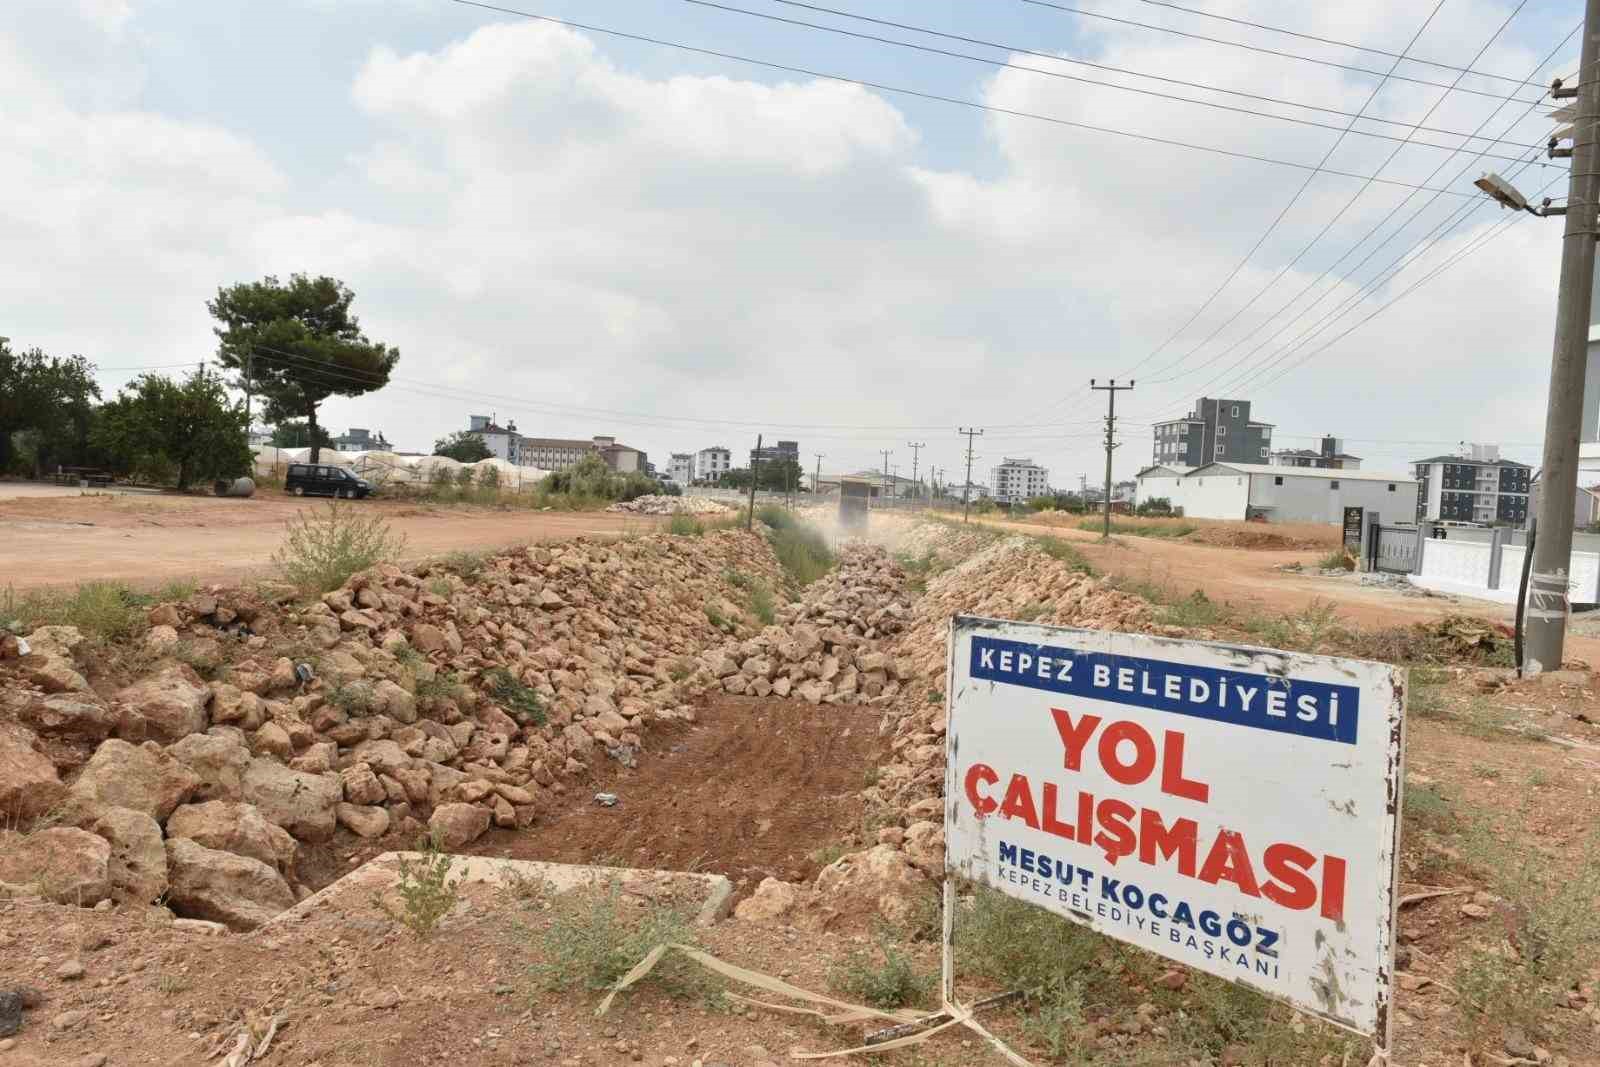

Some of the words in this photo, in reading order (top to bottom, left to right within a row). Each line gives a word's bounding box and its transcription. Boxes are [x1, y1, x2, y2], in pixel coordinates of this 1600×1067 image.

[980, 648, 1073, 682] KEPEZ
[1093, 664, 1339, 726] BELEDİYESİ
[1050, 707, 1209, 803] YOL
[964, 763, 1346, 921] ÇALIŞMASI
[998, 841, 1094, 893] MESUT
[1101, 874, 1280, 958] KOCAGÖZ
[998, 865, 1052, 897] KEPEZ
[1058, 888, 1160, 936] BELEDİYE
[1170, 928, 1278, 979] BAŞKANI
